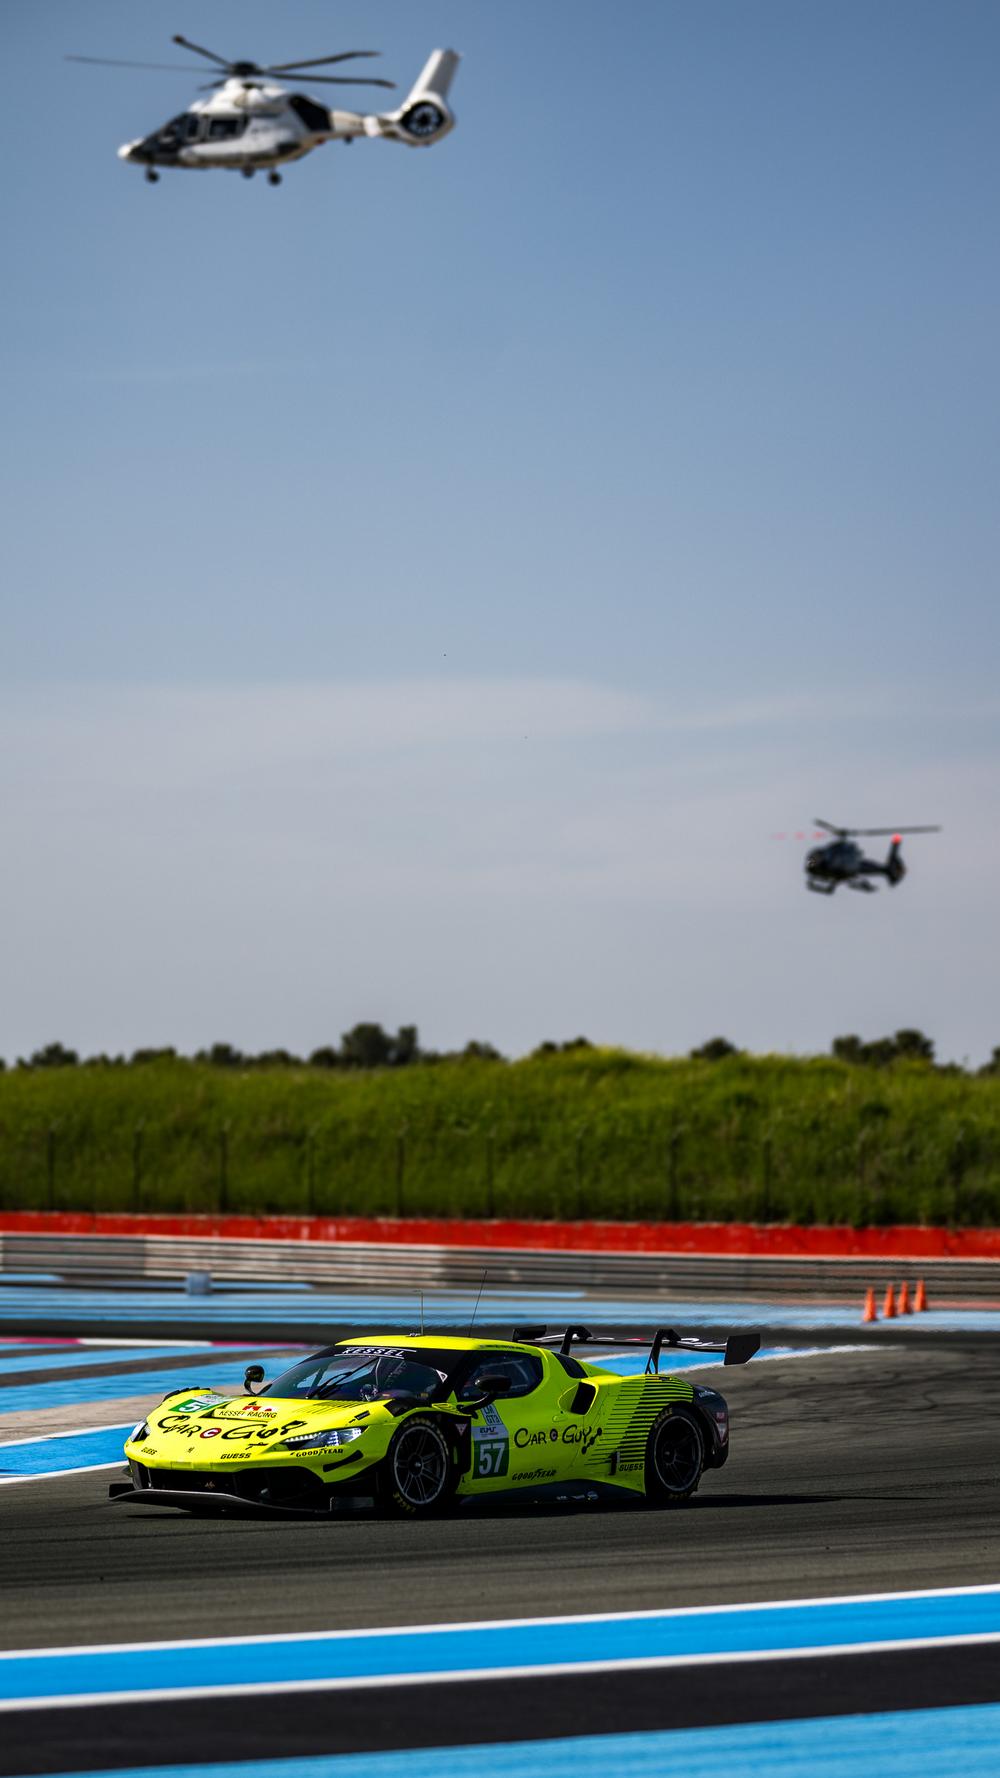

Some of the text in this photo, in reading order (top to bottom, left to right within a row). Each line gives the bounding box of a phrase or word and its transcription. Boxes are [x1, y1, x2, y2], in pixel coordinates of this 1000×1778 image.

[342, 1347, 404, 1357] KESSEL
[247, 1411, 277, 1419] RACING
[514, 1428, 547, 1448] CAR
[562, 1424, 592, 1444] GUY
[220, 1452, 252, 1460] GUESS
[296, 1448, 344, 1458] GOODYEAR
[480, 1442, 506, 1475] 57
[619, 1462, 644, 1472] GUESS
[512, 1469, 557, 1480] GOODYEAR
